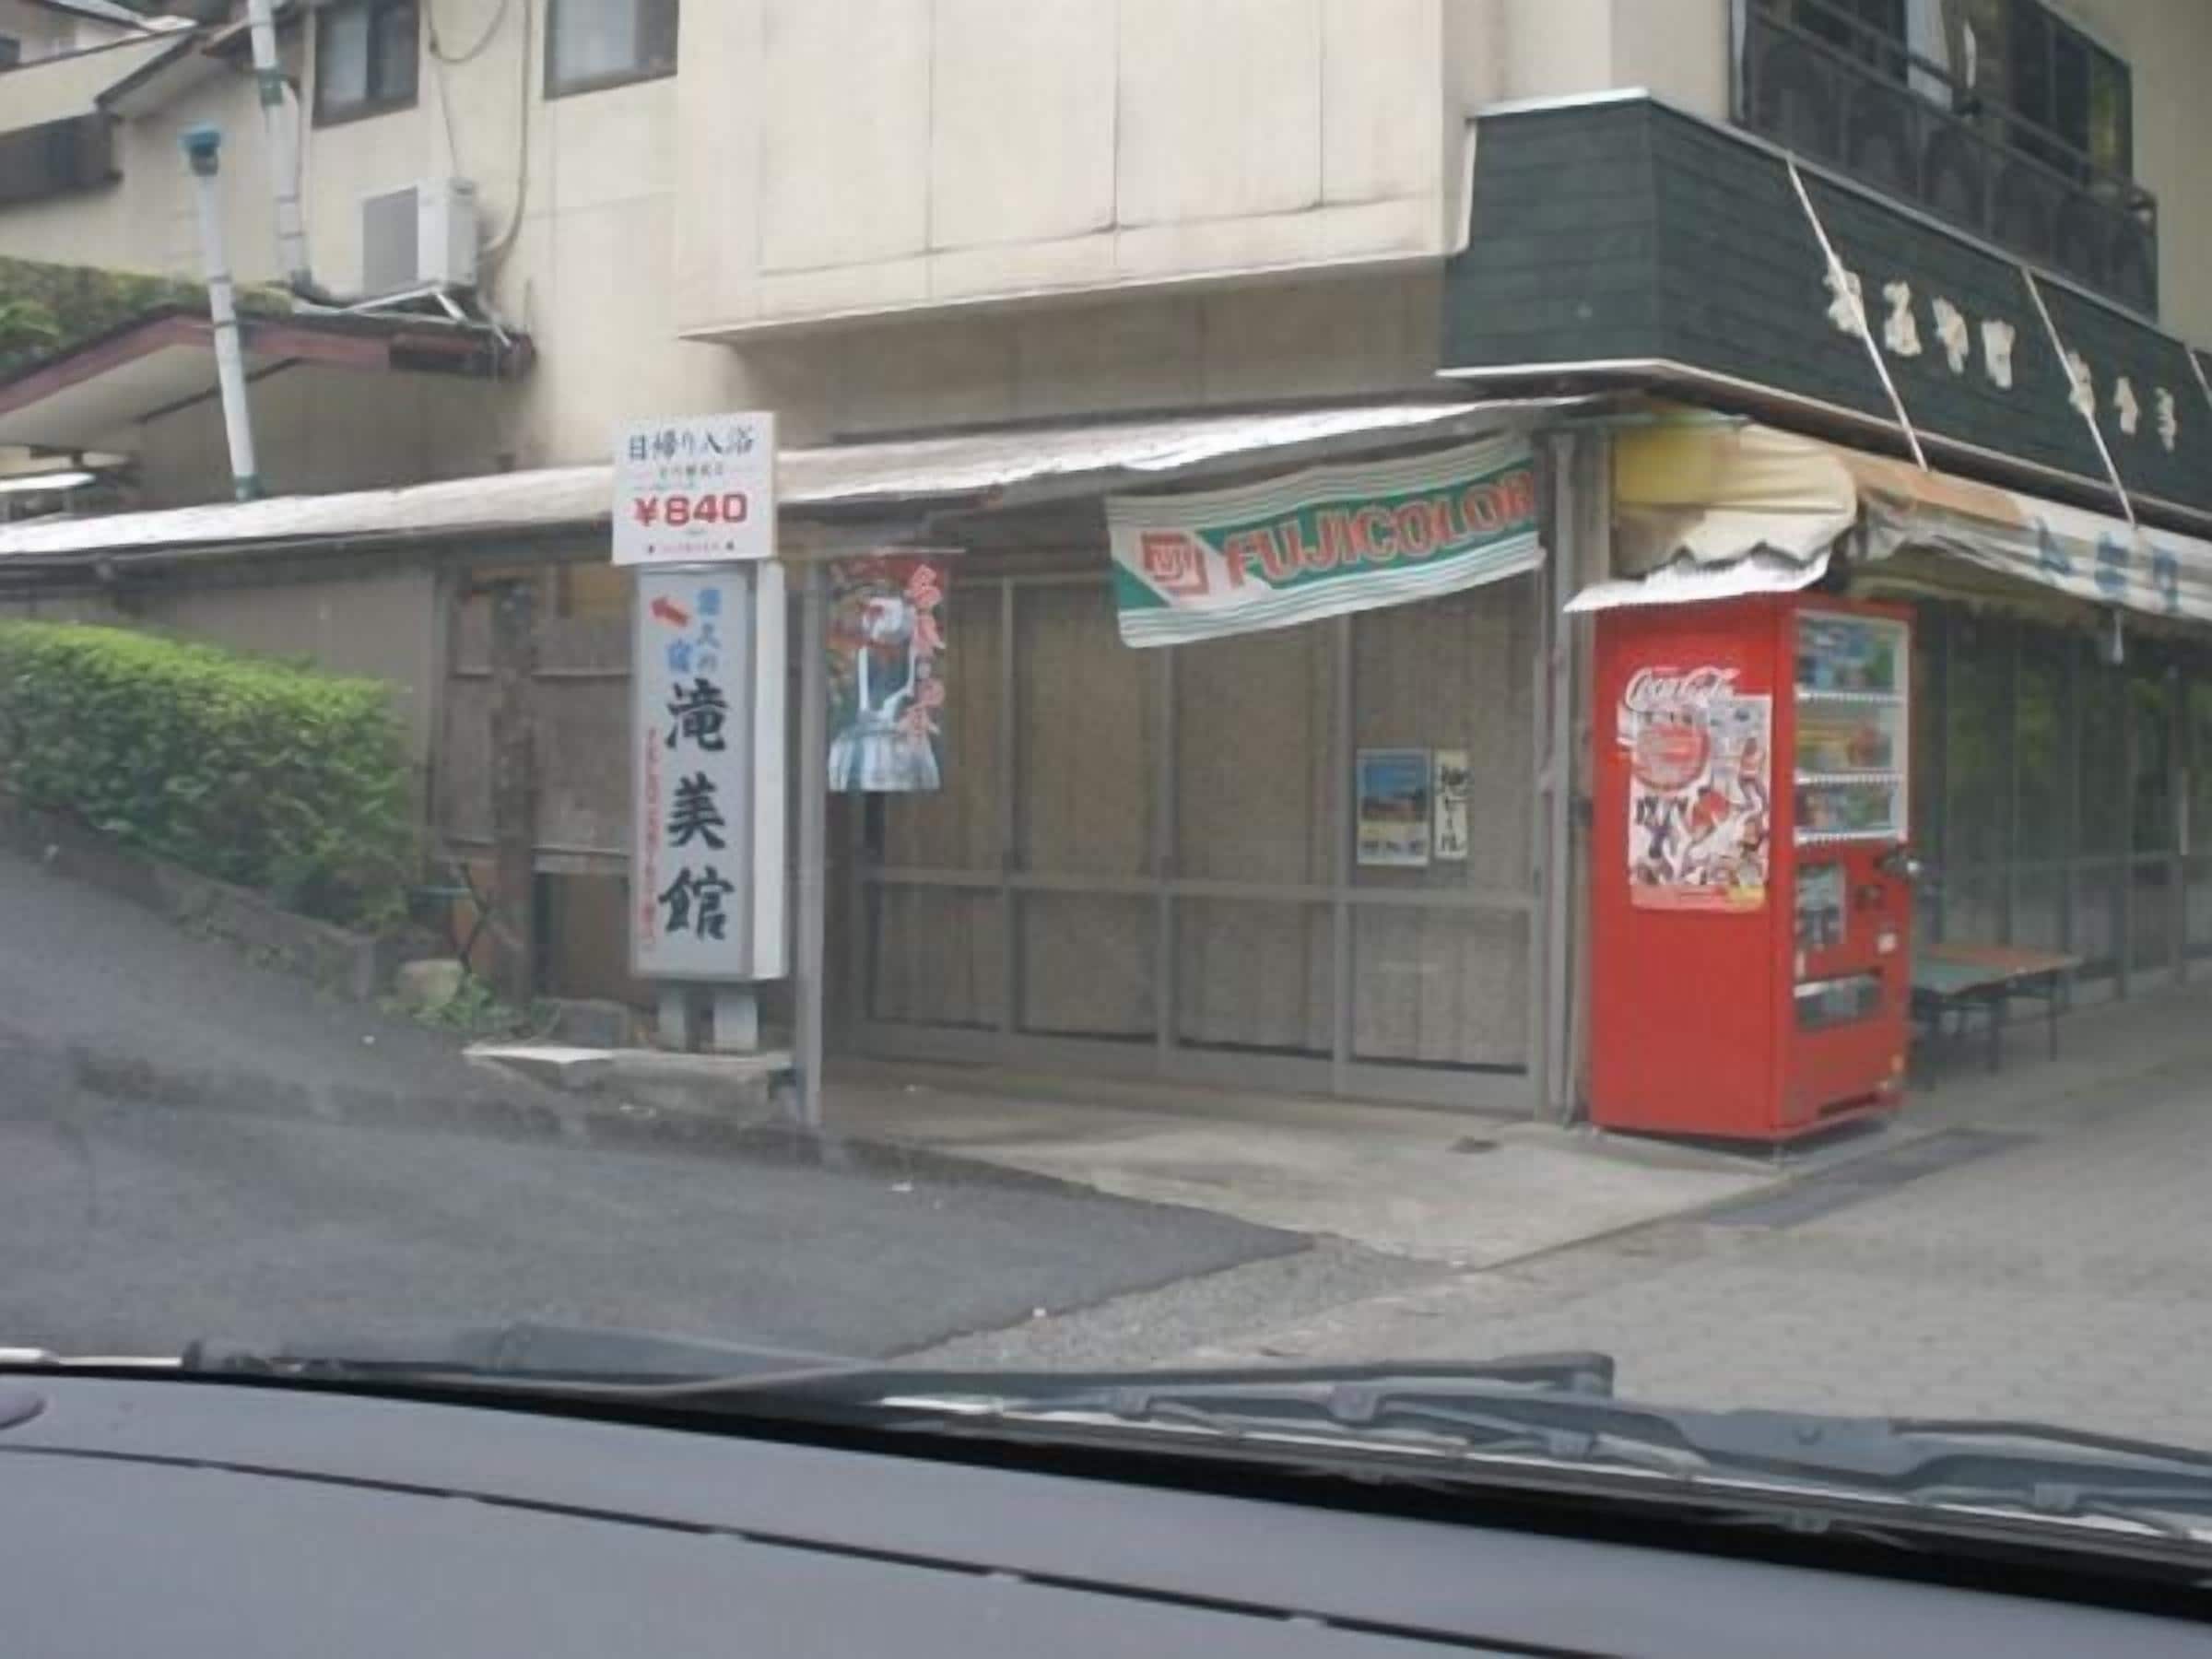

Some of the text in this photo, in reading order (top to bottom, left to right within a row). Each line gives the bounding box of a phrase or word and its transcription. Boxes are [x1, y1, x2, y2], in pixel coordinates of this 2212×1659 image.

[629, 425, 754, 461] 日帰り入浴
[633, 493, 747, 527] ¥840
[657, 677, 735, 941] 滝美館
